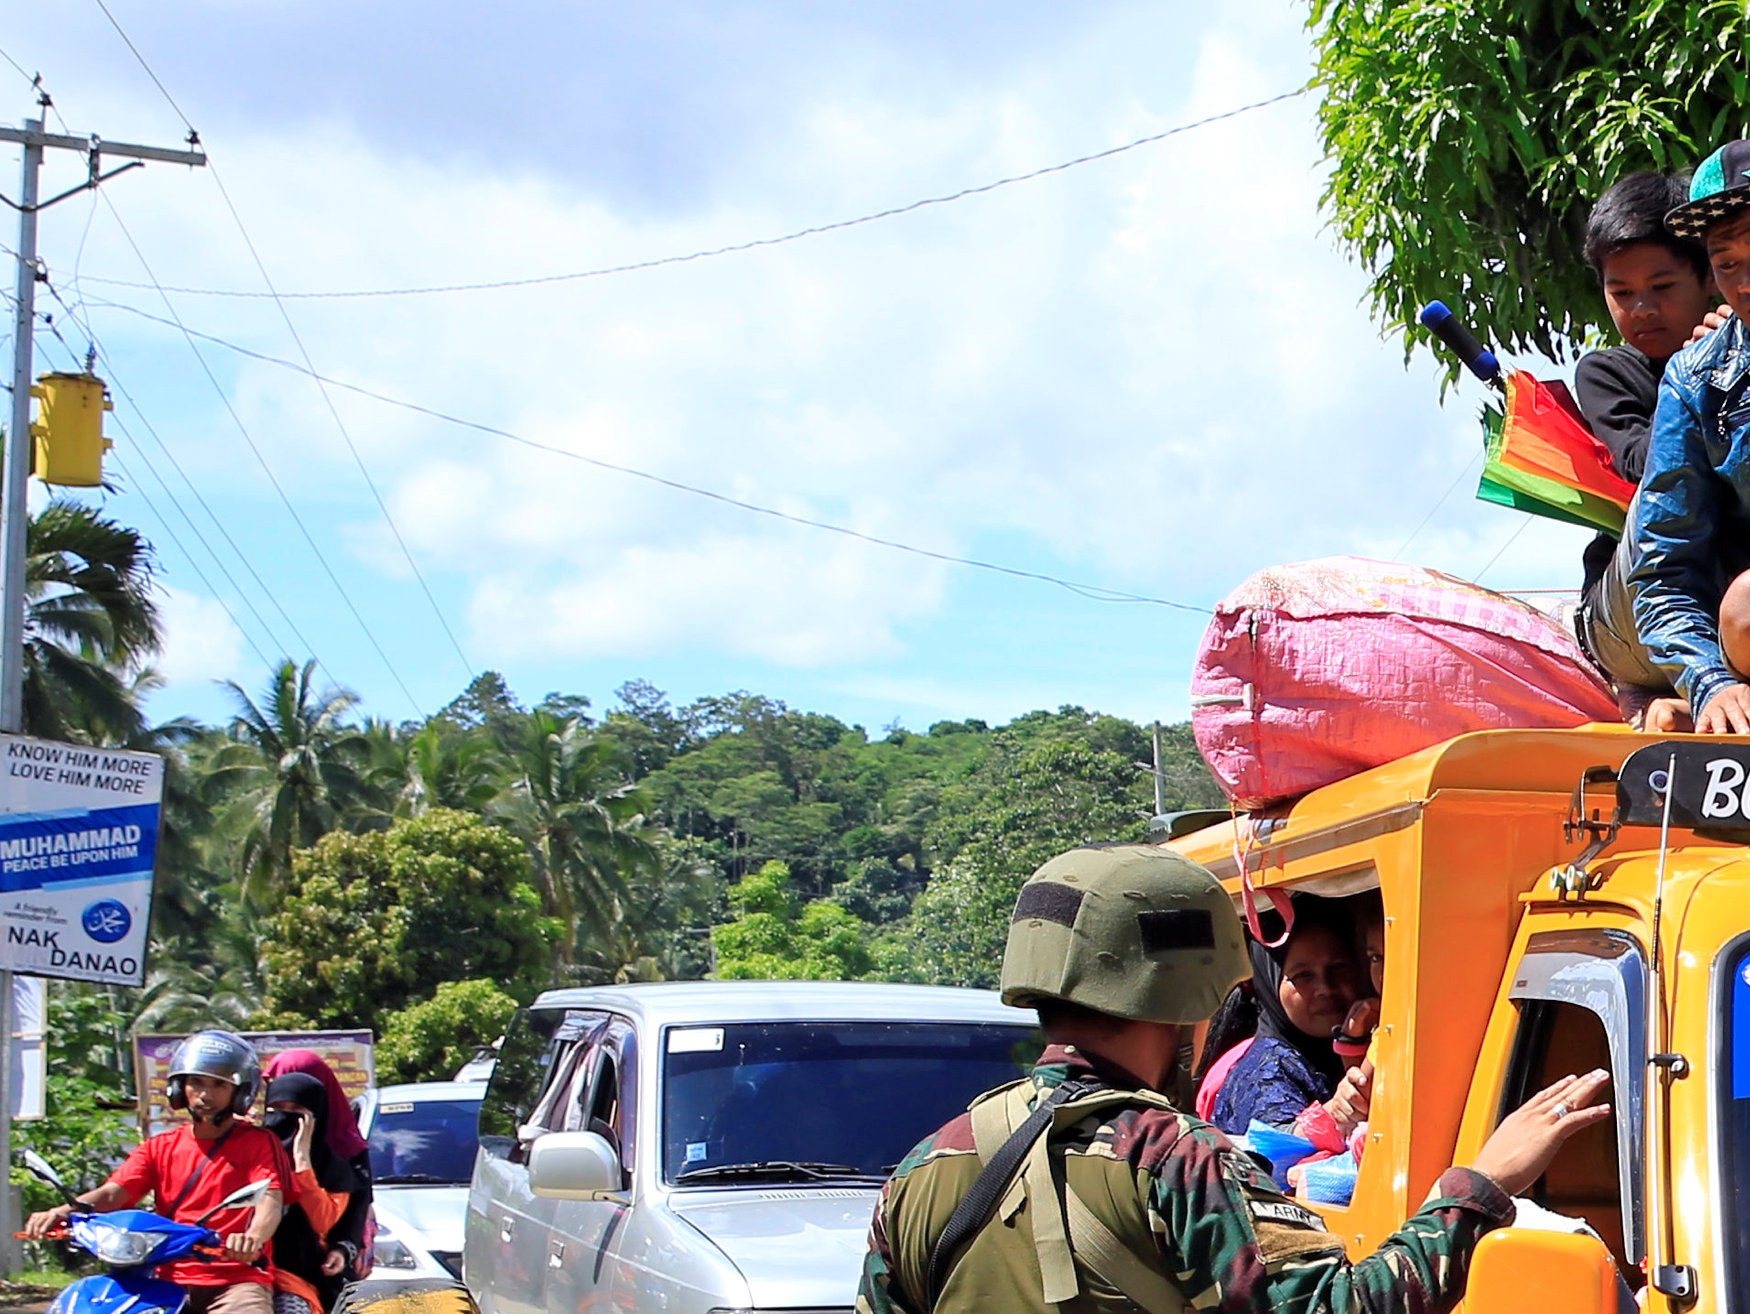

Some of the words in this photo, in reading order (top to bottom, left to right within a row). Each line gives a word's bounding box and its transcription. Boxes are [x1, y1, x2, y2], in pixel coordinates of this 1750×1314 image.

[8, 742, 63, 764] KNOW
[65, 752, 99, 770] HIM
[101, 756, 153, 777] MORE
[10, 762, 56, 783] LOVE
[57, 770, 92, 788] HIM
[94, 775, 146, 796] MORE
[0, 824, 141, 860] MUHAMMAD
[3, 852, 48, 873] PEACE
[50, 850, 68, 867] BE
[71, 846, 109, 866] UPON
[111, 844, 139, 861] HIM
[8, 926, 60, 949] NAK
[50, 948, 138, 976] DANAO
[1273, 1204, 1312, 1225] ARMY
